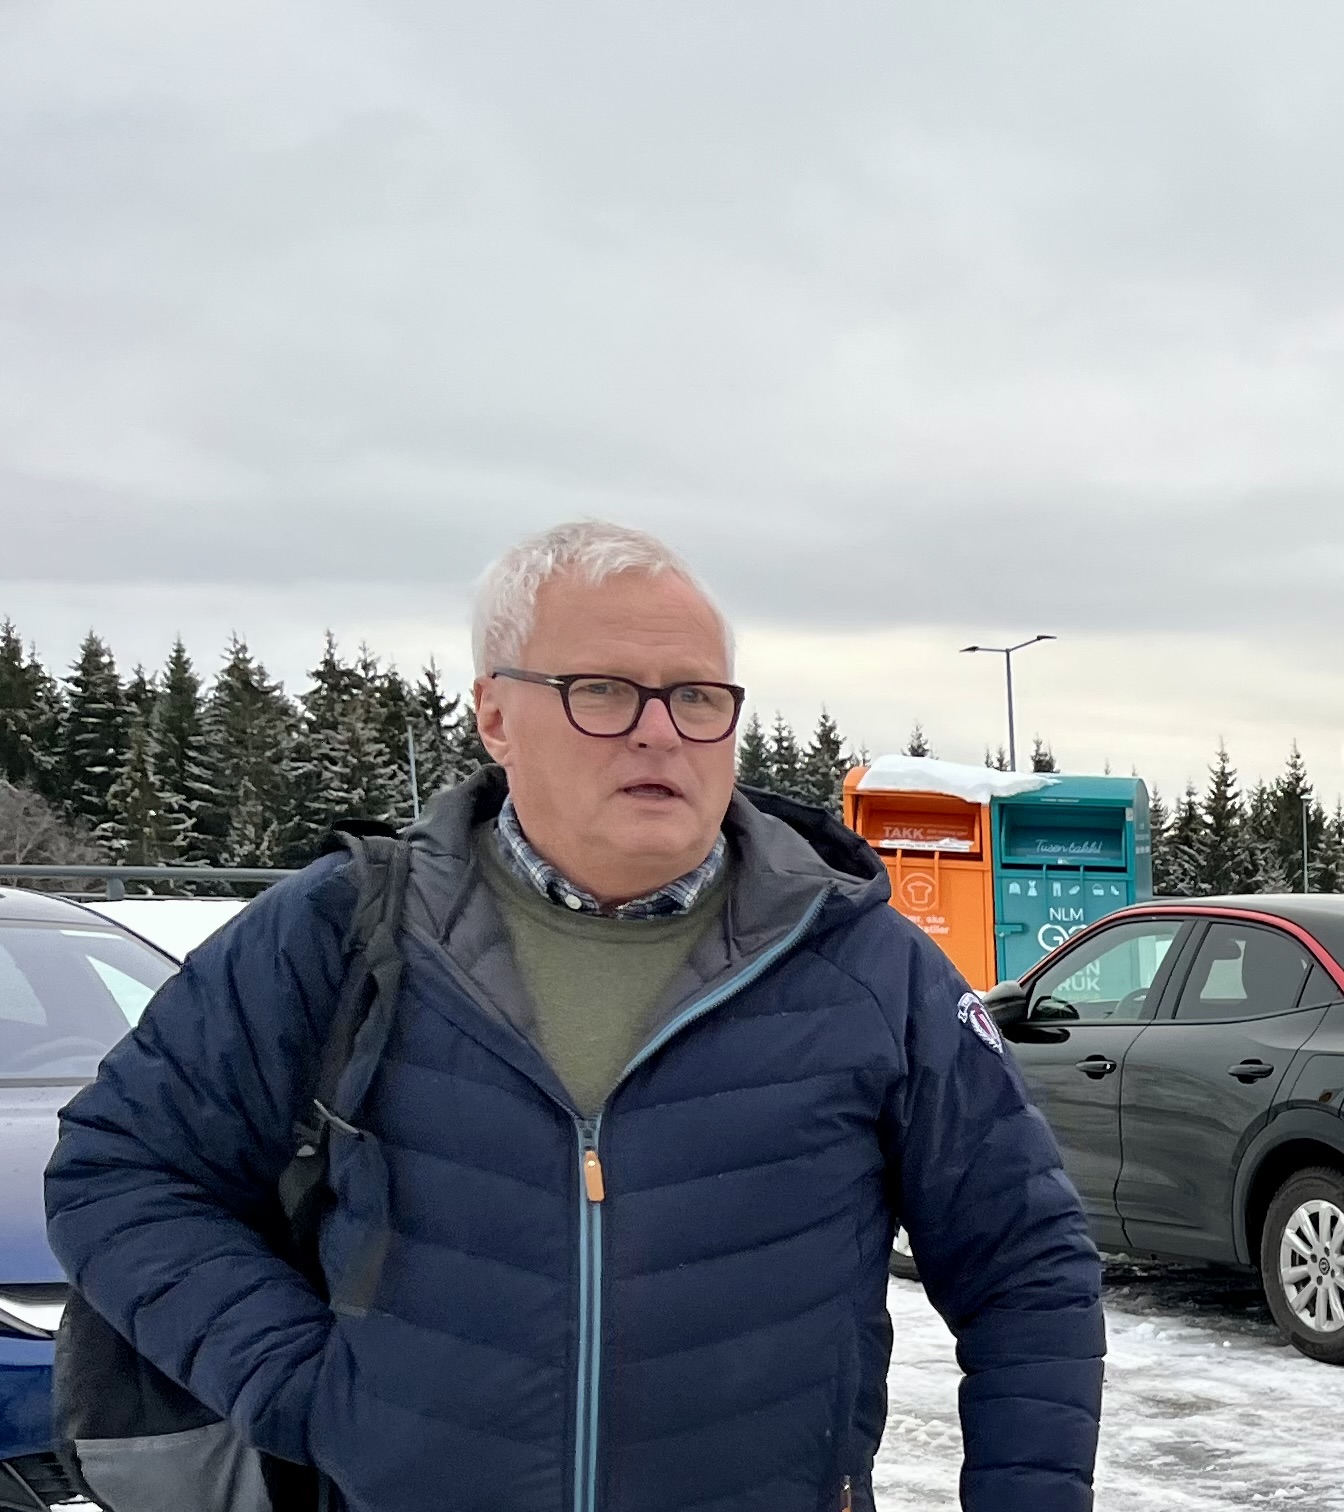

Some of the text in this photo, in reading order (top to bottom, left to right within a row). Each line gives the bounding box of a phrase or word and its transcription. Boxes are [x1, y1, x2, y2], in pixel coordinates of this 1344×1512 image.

[883, 826, 924, 839] TAKK
[1049, 907, 1084, 921] NLM
[1057, 976, 1101, 991] RUK
